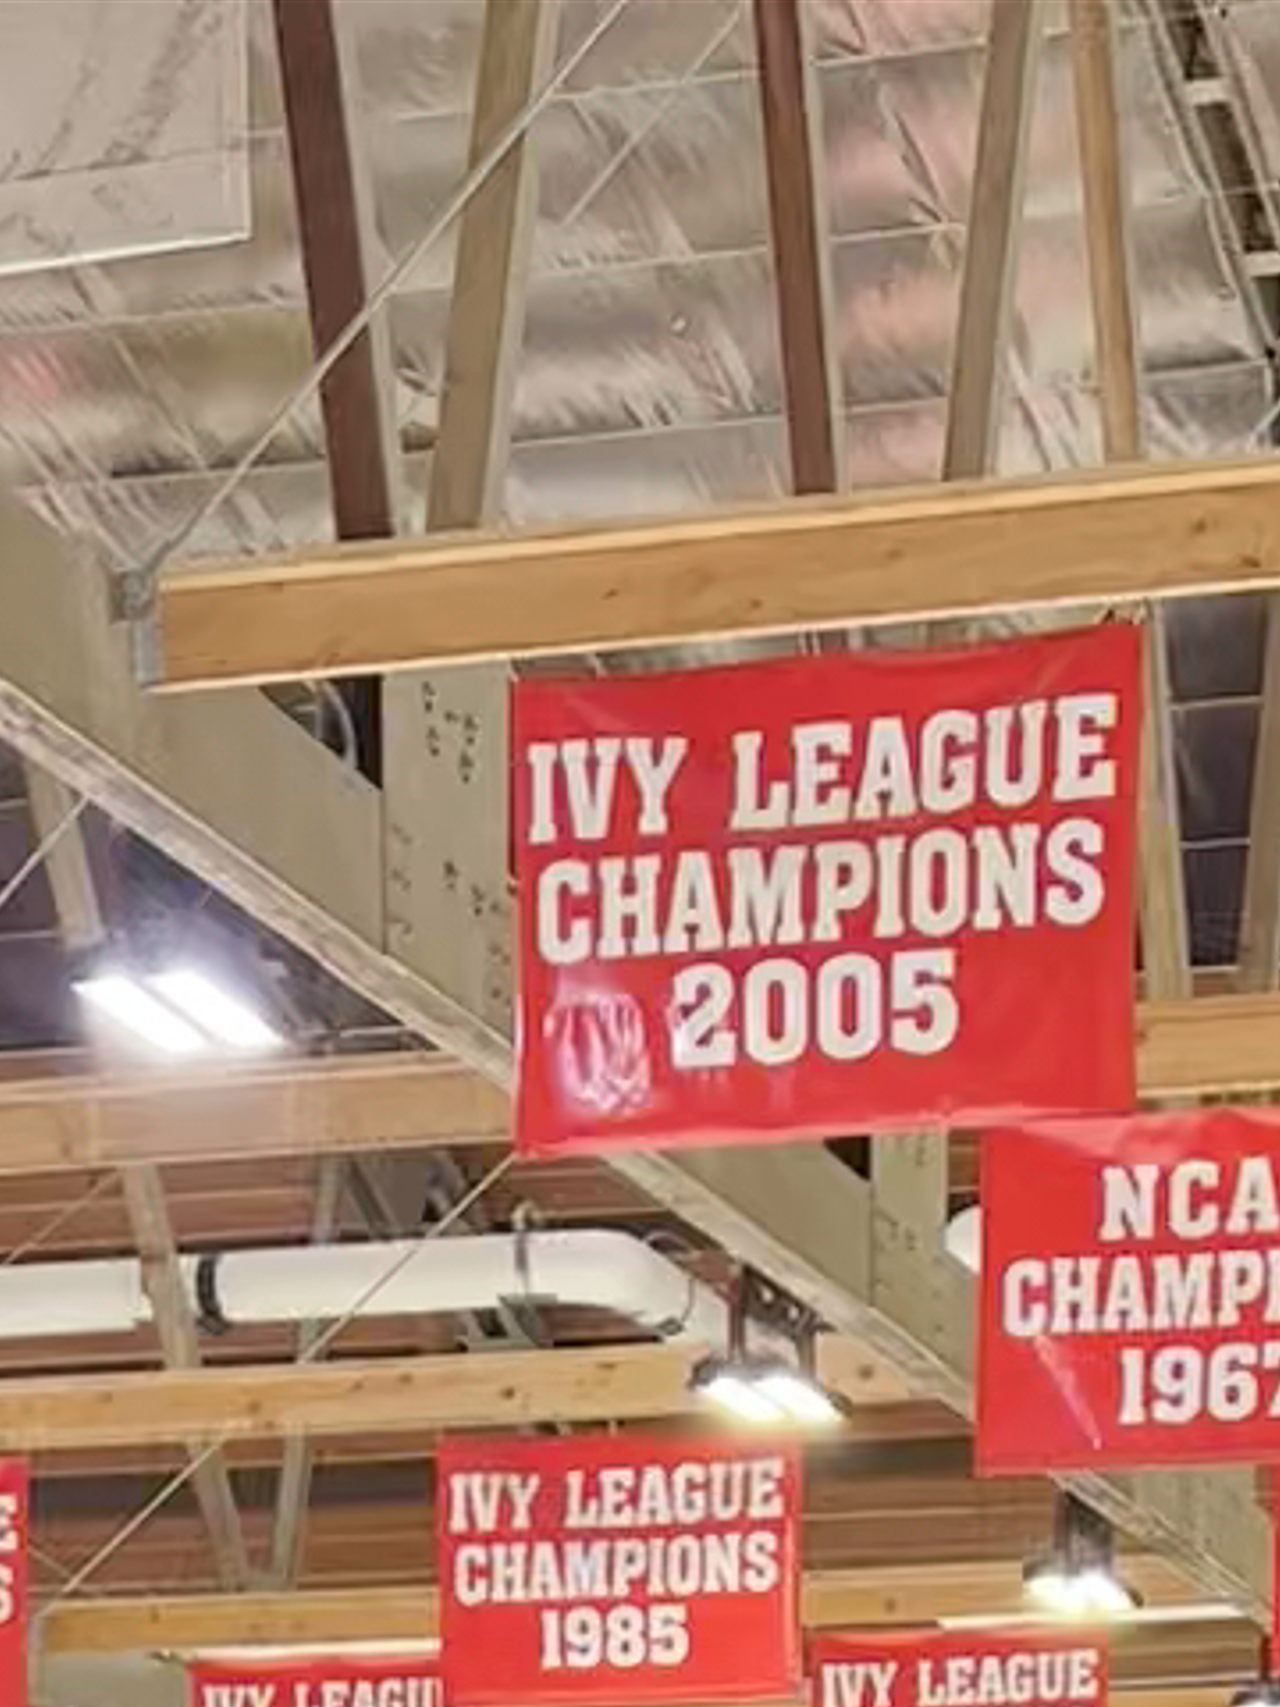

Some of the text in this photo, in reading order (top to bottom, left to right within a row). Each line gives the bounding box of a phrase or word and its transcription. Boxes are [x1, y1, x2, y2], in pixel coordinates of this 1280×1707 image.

[527, 694, 1119, 845] IVY LEAGUE
[536, 818, 1106, 965] CHAMPIONS
[672, 947, 960, 1069] 2005
[448, 1457, 784, 1535] IVY LEAGUE
[453, 1530, 780, 1607] CHAMPIONS
[540, 1606, 689, 1671] 1985
[917, 1649, 1099, 1705] LEAGUE
